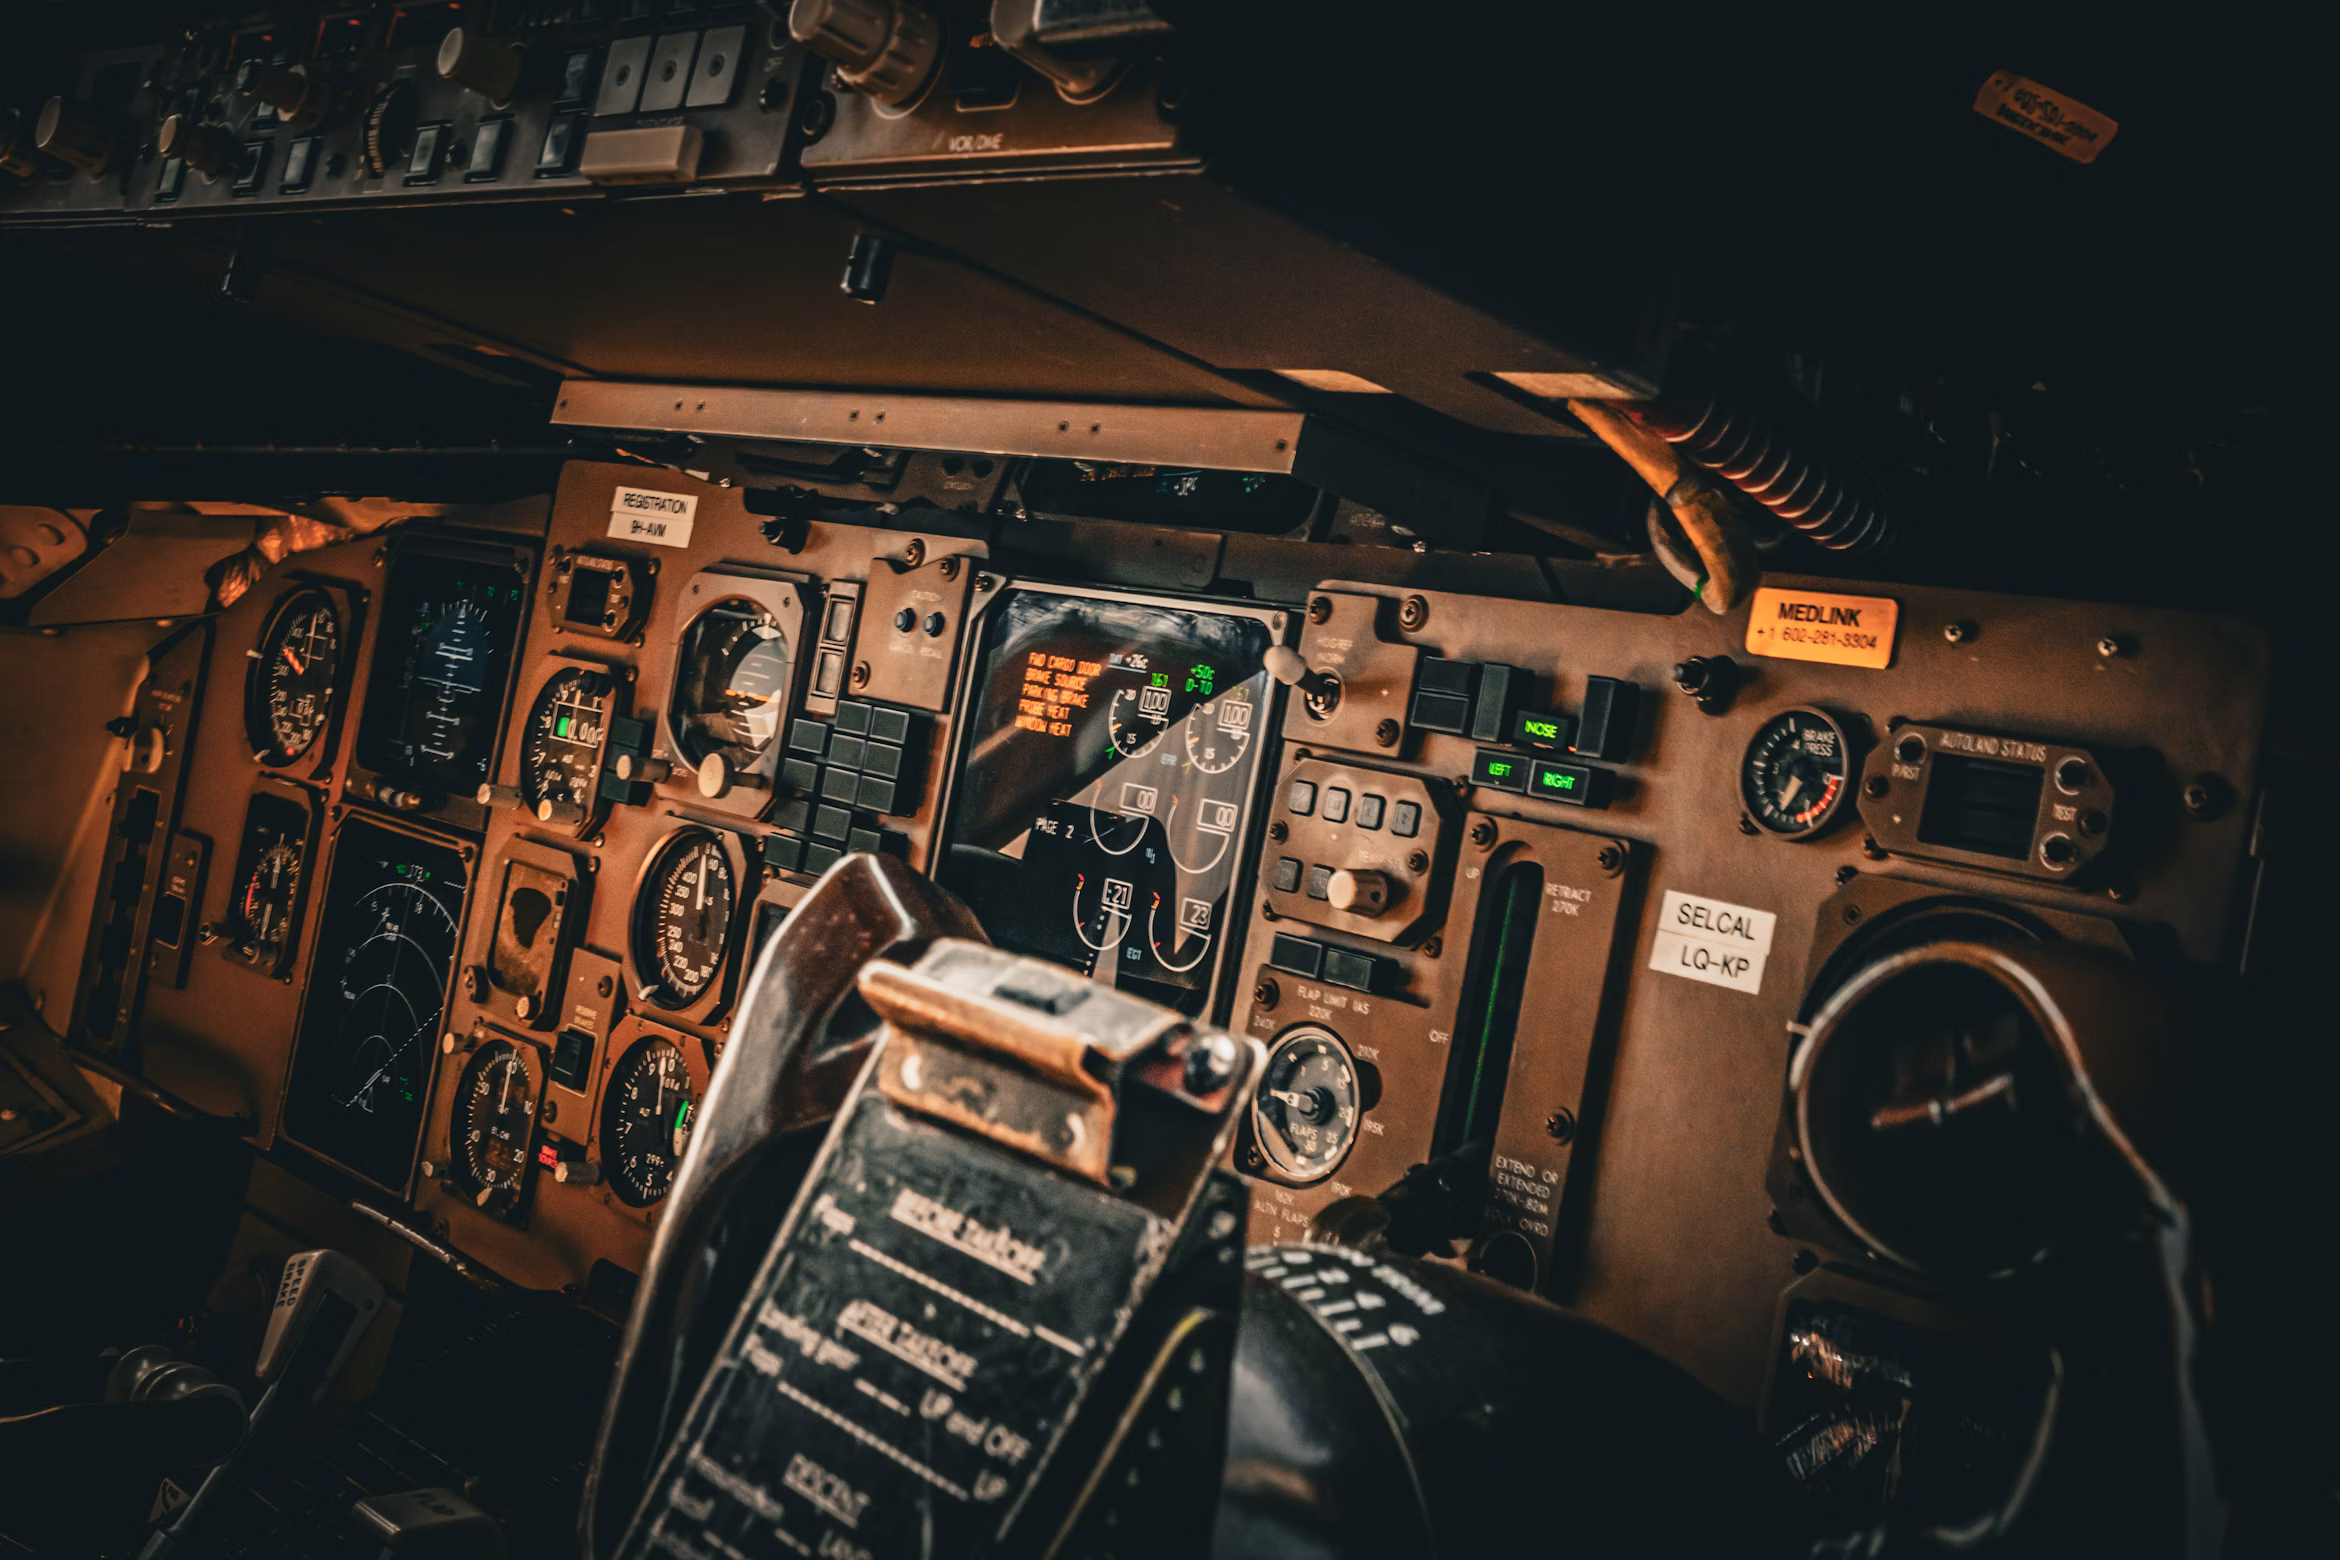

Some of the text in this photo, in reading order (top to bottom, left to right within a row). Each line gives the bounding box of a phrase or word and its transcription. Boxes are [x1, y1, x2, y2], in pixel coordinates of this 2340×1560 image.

[624, 493, 688, 514] REGISTRATION
[1777, 602, 1862, 627] MEDLINK
[1769, 628, 1776, 641] 1
[1782, 627, 1877, 650] 602-281-3304
[1047, 655, 1076, 672] CARGO
[1076, 660, 1101, 676] DOOR
[1025, 667, 1088, 691] BRAKE SOURCE
[1022, 683, 1089, 708] PARKING BRAKE
[1047, 704, 1070, 719] HEAT
[1015, 715, 1072, 737] WINDOW HEAT
[1524, 719, 1558, 739] NOSE
[1803, 728, 1836, 745] BRAKE
[1804, 742, 1833, 757] PRESS
[1938, 732, 2046, 763] AUTOLAND STATUS
[1488, 761, 1512, 777] LEFT
[1542, 771, 1575, 790] RIGHT
[2052, 803, 2078, 823] TEST
[1035, 817, 1075, 839] PAGE 2
[1545, 882, 1592, 902] RETRACT
[1190, 904, 1209, 925] 23
[1552, 899, 1581, 917] 270K
[1678, 903, 1755, 941] SELCAL
[1681, 945, 1750, 978] LQ-KP
[683, 968, 700, 983] 200
[1297, 985, 1321, 1001] FLAP
[1323, 991, 1347, 1009] LIMIT
[1309, 1004, 1333, 1021] 220K
[1290, 1122, 1318, 1141] FLAPS
[513, 1148, 524, 1164] 20
[1496, 1155, 1560, 1186] EXTEND OR
[1497, 1171, 1550, 1199] EXTENDED
[1281, 1207, 1310, 1228] FLAPS
[275, 1261, 297, 1309] BRAKE
[286, 1259, 307, 1307] SPEED
